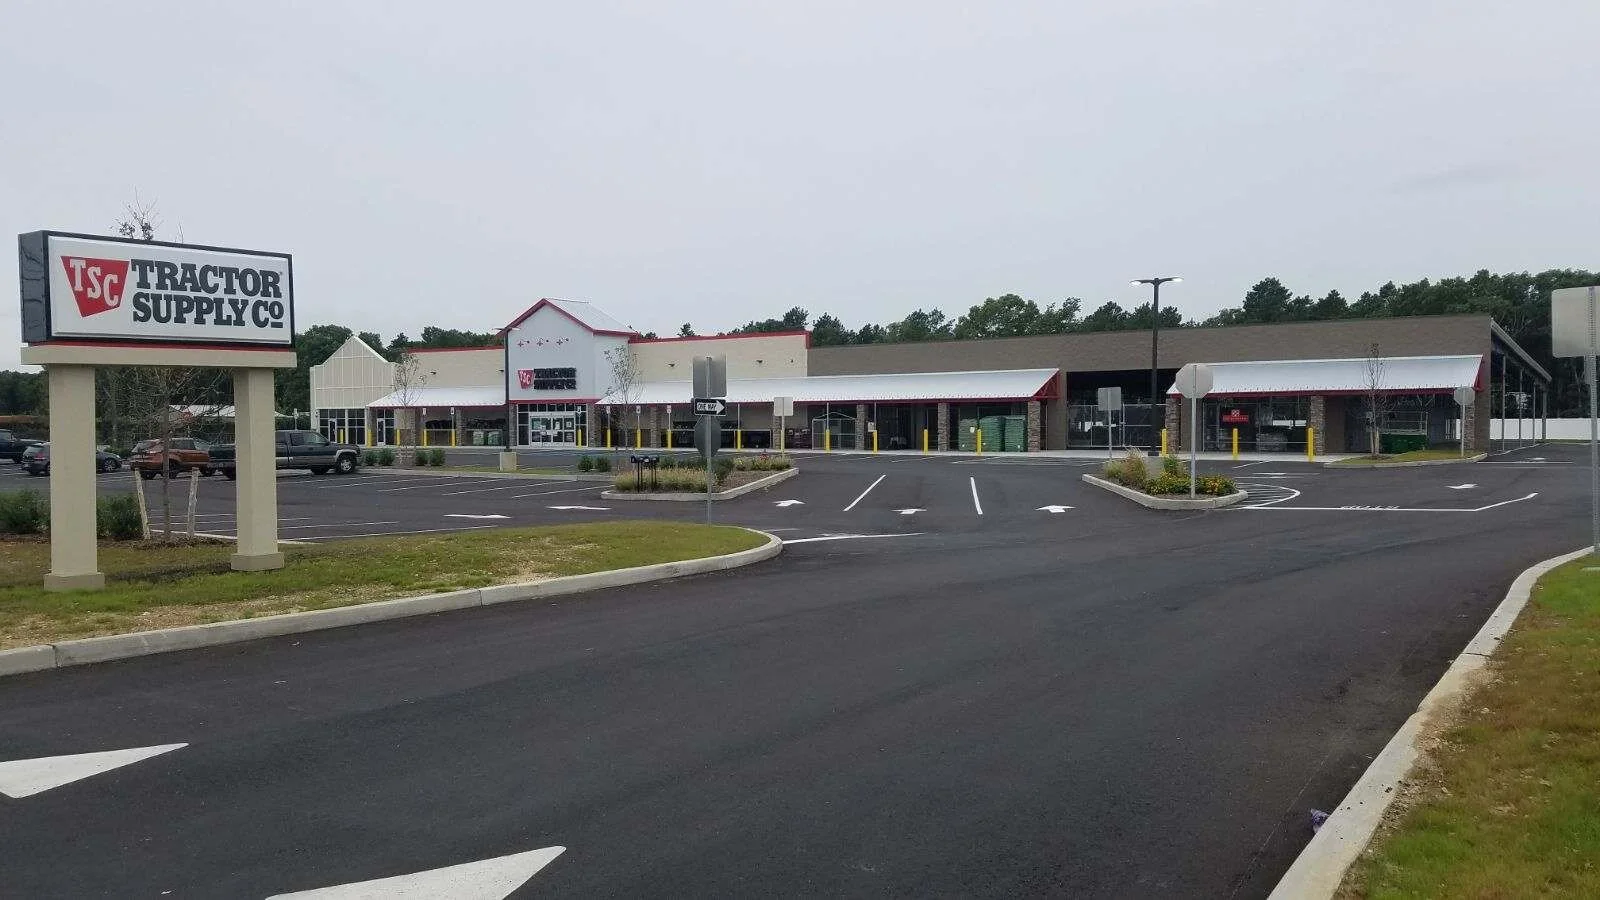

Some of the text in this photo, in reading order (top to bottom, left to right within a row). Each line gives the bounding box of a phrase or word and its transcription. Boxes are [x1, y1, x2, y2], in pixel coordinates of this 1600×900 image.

[70, 258, 119, 307] TSC
[131, 259, 283, 298] TRACTOR
[132, 291, 248, 327] SUPPLY
[697, 402, 717, 410] ONE WAY
